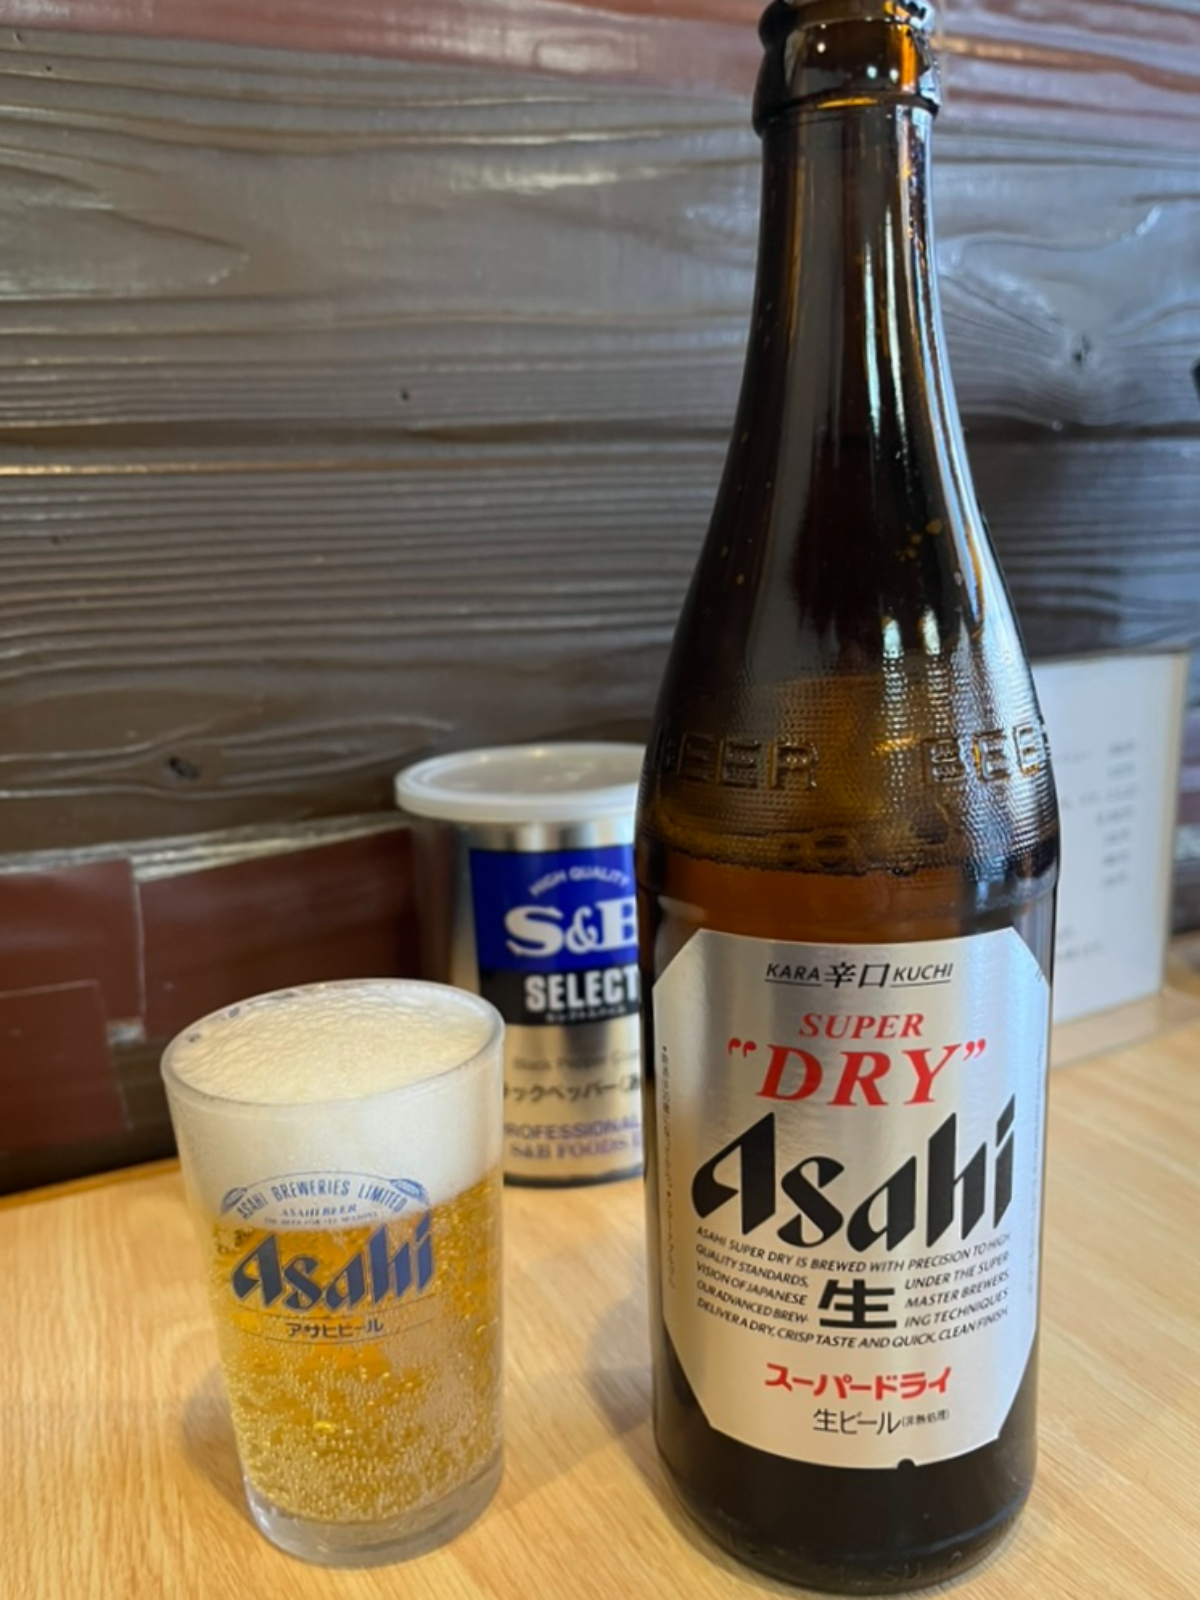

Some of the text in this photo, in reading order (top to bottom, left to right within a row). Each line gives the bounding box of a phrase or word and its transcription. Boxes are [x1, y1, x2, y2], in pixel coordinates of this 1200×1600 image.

[568, 865, 631, 888] QUALITY
[504, 896, 638, 957] S&B
[524, 963, 639, 1013] SELECT
[765, 961, 954, 989] KARA 辛口 KUCHI
[799, 1012, 925, 1040] SUPER
[271, 1179, 351, 1202] BREWERIES
[358, 1183, 408, 1213] LIMITED
[691, 1093, 1016, 1253] Asahi
[231, 1210, 434, 1313] Asahi
[696, 1226, 727, 1247] ASAHI
[729, 1239, 766, 1259] SUPER
[768, 1250, 795, 1267] DRY
[796, 1256, 808, 1268] IS
[810, 1258, 867, 1273] BREWED
[869, 1260, 906, 1273] WITH
[907, 1247, 971, 1271] PRECISION
[972, 1241, 988, 1257] TO
[696, 1243, 738, 1268] QUALITY
[904, 1272, 950, 1290] UNDER
[953, 1266, 977, 1282] THE
[977, 1250, 1010, 1275] SUPER
[696, 1260, 731, 1286] VISION
[730, 1277, 747, 1290] OF
[745, 1282, 808, 1306] JAPANESE
[904, 1288, 960, 1309] MASTER
[713, 1287, 773, 1317] ADVANCED
[904, 1313, 932, 1328] ING
[933, 1286, 1009, 1323] TECHNIQUES
[818, 1278, 897, 1329] 生
[285, 1318, 384, 1339] アサヒビール
[696, 1297, 739, 1326] DELIVER
[738, 1317, 749, 1329] A
[749, 1319, 777, 1337] DRY,
[777, 1327, 815, 1343] CRISP
[816, 1334, 857, 1349] TASTE
[858, 1336, 891, 1349] AND
[938, 1321, 976, 1341] CLEAN
[764, 1361, 952, 1401] スーパードライ
